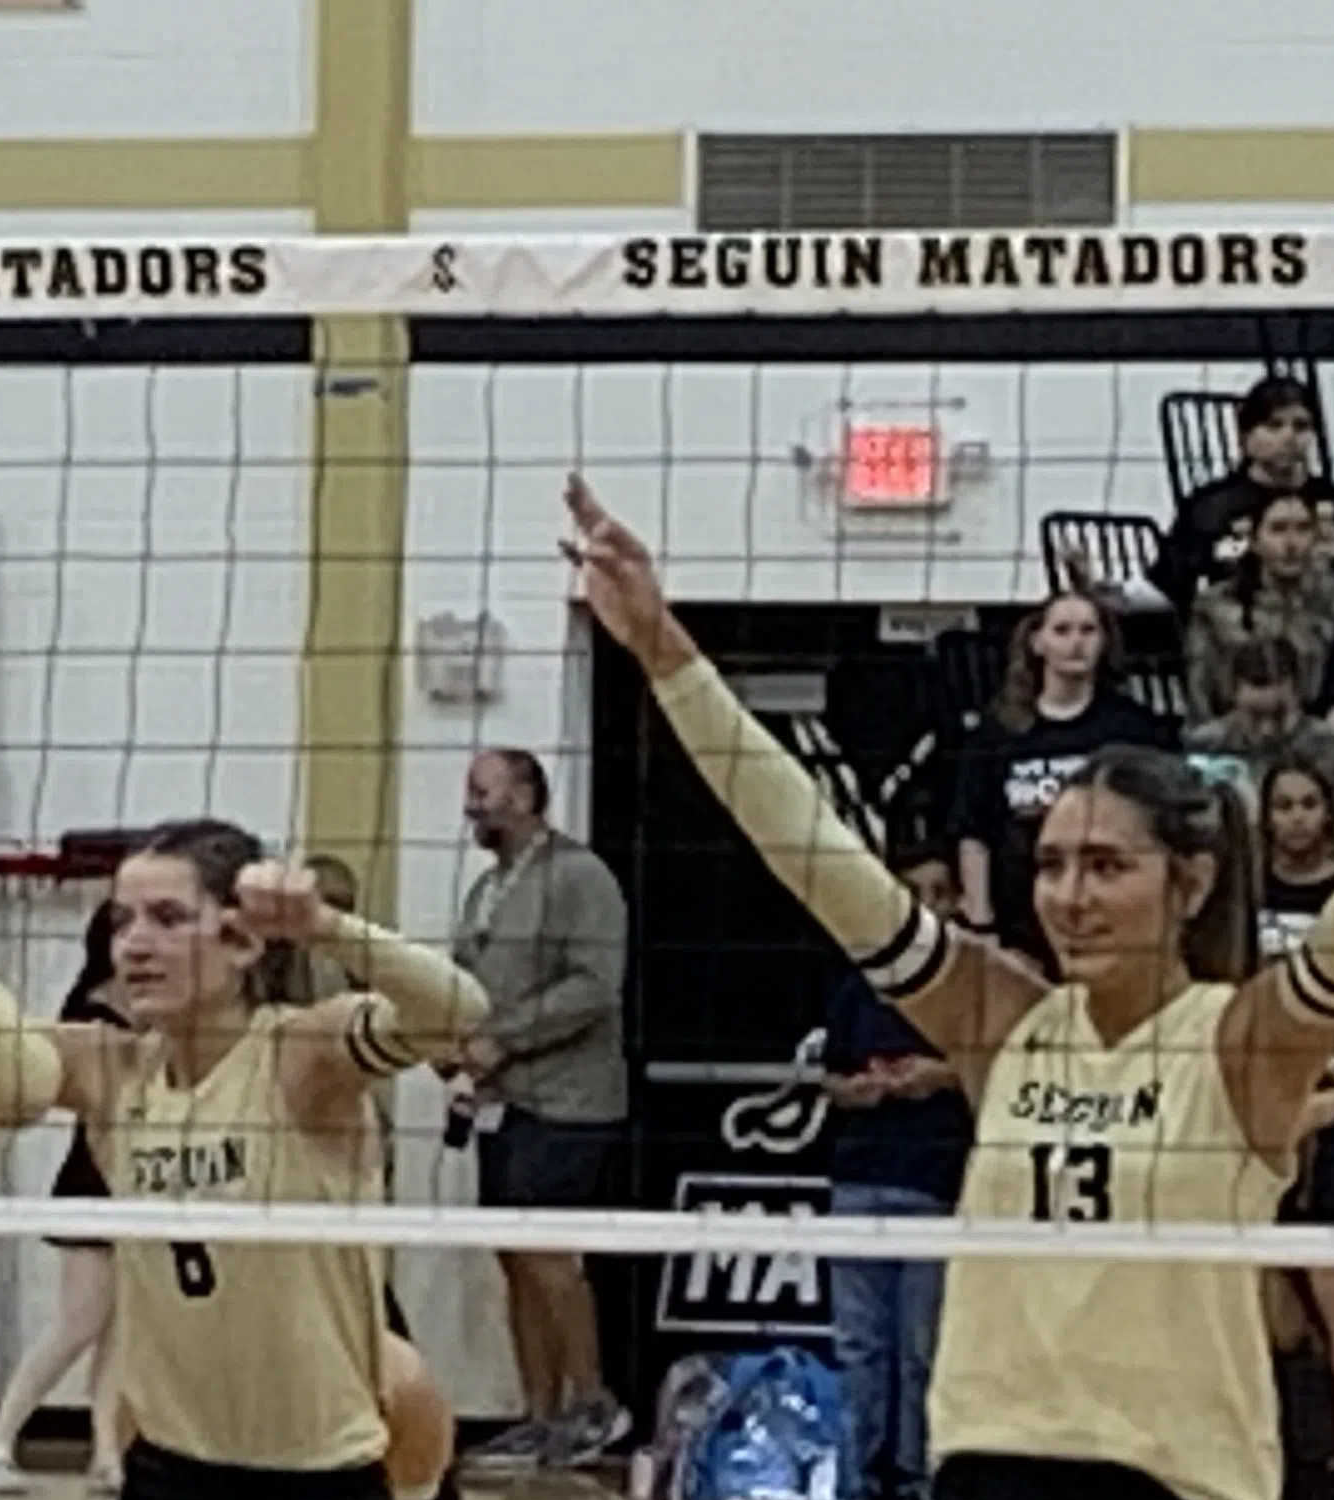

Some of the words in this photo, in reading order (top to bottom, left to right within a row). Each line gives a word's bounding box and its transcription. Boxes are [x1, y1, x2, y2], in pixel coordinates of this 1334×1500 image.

[622, 237, 883, 289] SEGUIN
[918, 234, 1308, 287] MATADORS
[1029, 1142, 1113, 1223] 13
